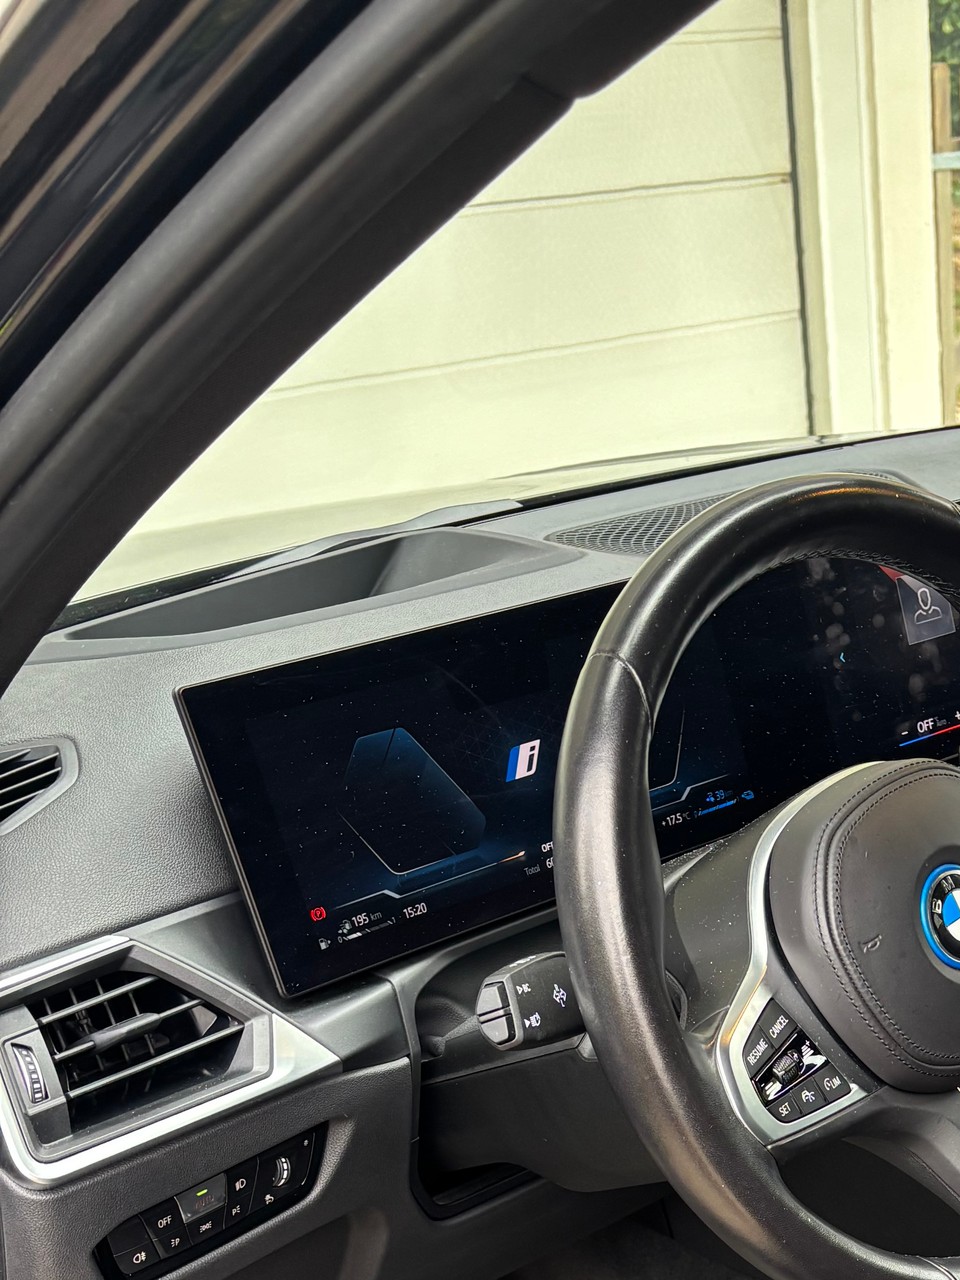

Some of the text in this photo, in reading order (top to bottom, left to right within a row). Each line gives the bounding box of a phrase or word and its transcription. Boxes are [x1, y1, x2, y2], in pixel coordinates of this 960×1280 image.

[917, 718, 934, 733] OFF
[523, 863, 541, 876] Total
[403, 902, 428, 919] 15:20
[351, 911, 383, 927] 195 km
[769, 1014, 789, 1039] CANCEL
[747, 1038, 769, 1066] RESUME
[831, 1075, 842, 1089] LIM
[778, 1102, 791, 1117] SET
[157, 1214, 172, 1228] OFF
